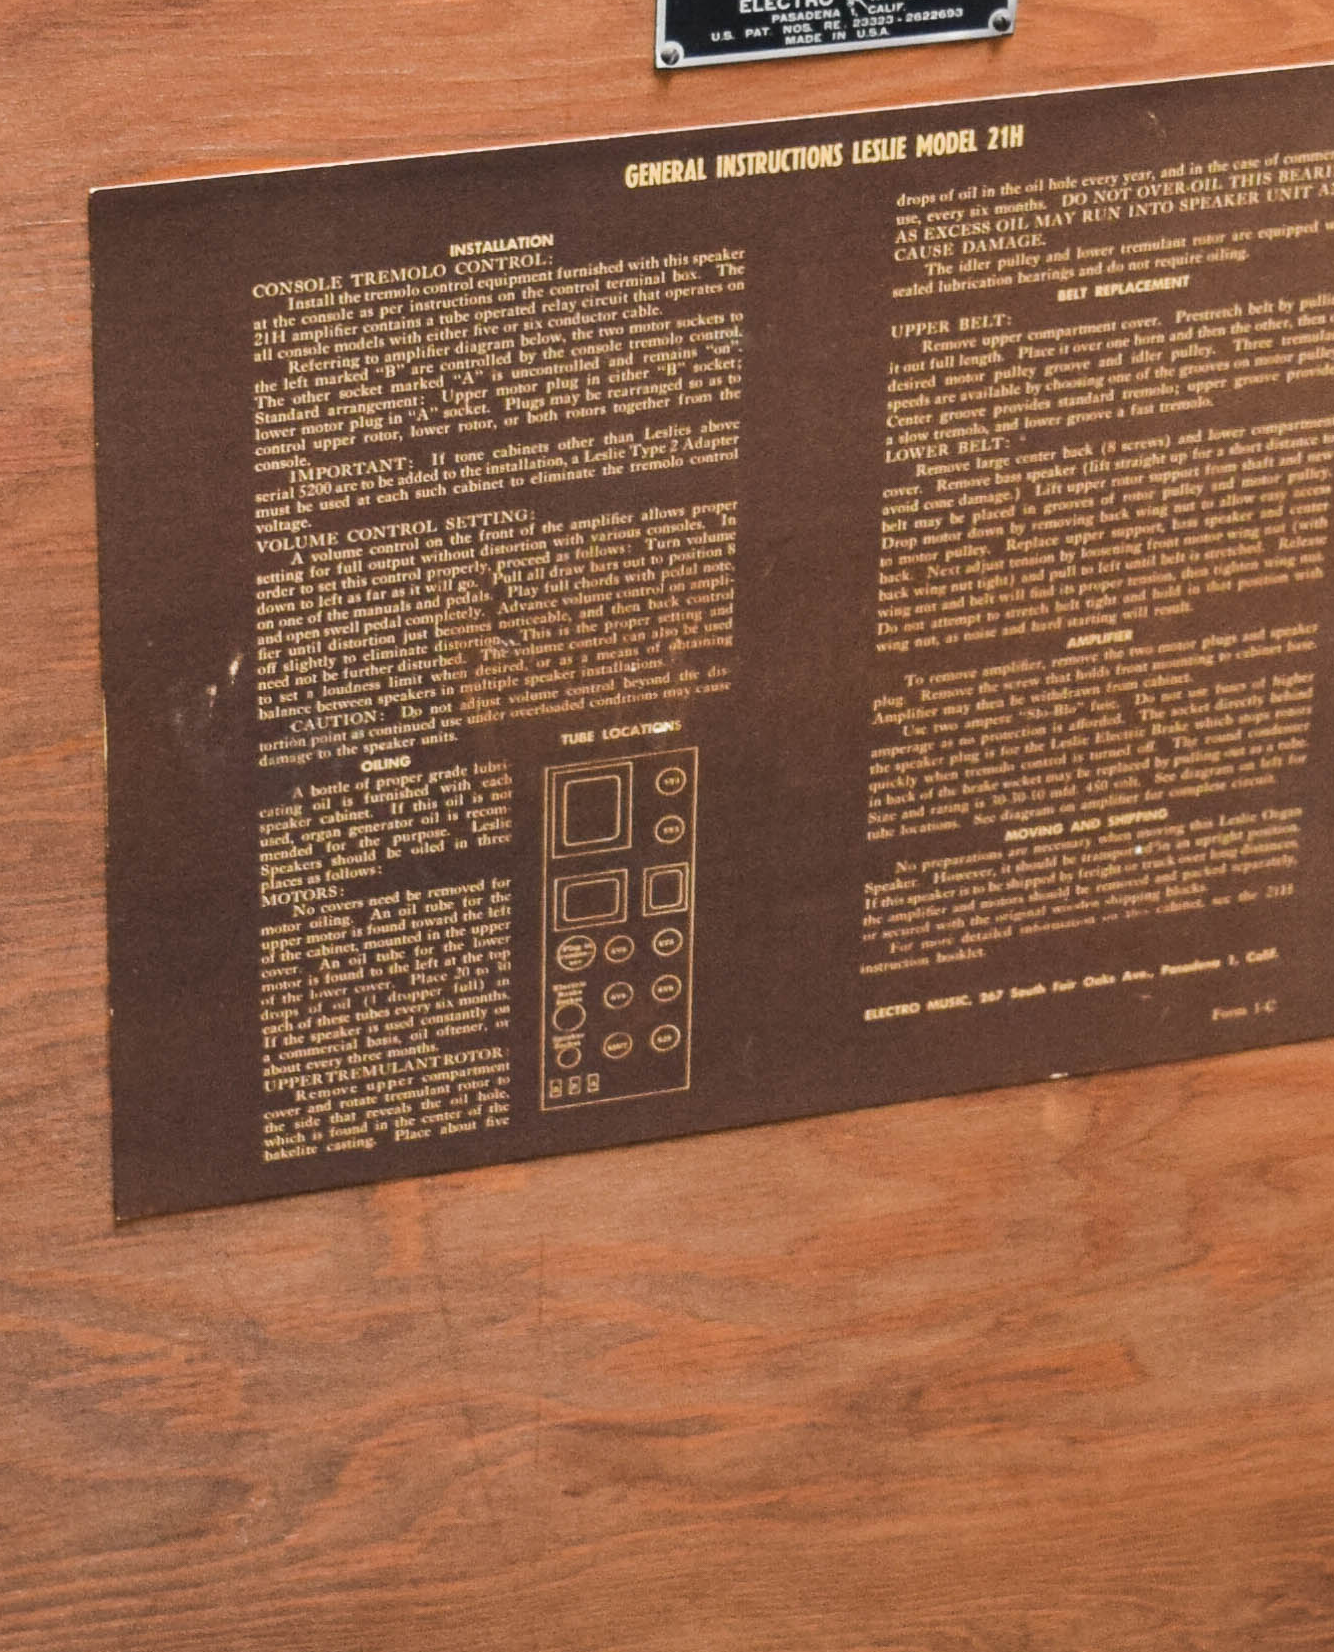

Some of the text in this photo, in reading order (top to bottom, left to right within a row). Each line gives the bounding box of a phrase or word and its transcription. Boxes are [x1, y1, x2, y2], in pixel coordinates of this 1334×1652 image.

[771, 9, 841, 24] PASADENA
[785, 33, 822, 45] MADE
[832, 32, 847, 42] IN
[624, 123, 1025, 189] GENERAL INSTRUCTIONS LESLIE MODEL 21H
[926, 210, 964, 222] every
[1061, 192, 1088, 208] DO
[1093, 186, 1132, 204] NOT
[1136, 177, 1222, 199] OVER-OIL
[1229, 172, 1272, 189] THIS
[894, 229, 918, 244] AS
[924, 220, 991, 241] EXCESS
[996, 216, 1029, 232] OIL
[1035, 210, 1076, 228] MAY
[1082, 205, 1121, 223] RUN
[1128, 200, 1174, 218] INTO
[1179, 191, 1260, 212] SPEAKER
[1266, 185, 1314, 202] UNIT
[449, 233, 555, 258] INSTALLATION
[893, 242, 954, 262] CAUSE
[251, 252, 553, 299] CONSOLE TREMOLO CONTROL:
[288, 248, 746, 311] Install the tremolo control equipment furnished with this speaker
[1056, 273, 1191, 303] BELT REPLACEMENT
[253, 264, 746, 331] at the console as per instructions on the control terminal box. The
[890, 319, 951, 339] UPPER
[289, 456, 414, 484] IMPORTANT:
[454, 450, 485, 464] tone
[492, 442, 550, 459] cabinets
[557, 436, 595, 451] other
[603, 432, 634, 446] than
[644, 425, 692, 441] Leslies
[699, 420, 741, 434] above
[884, 443, 949, 464] LOWER
[255, 508, 536, 554] VOLUME CONTROL SETTING:
[559, 719, 682, 746] TUBE LOCATIONS
[359, 754, 412, 773] OILING
[258, 865, 383, 895] places as follows:
[260, 885, 345, 908] MOTORS:
[292, 877, 512, 918] No covers need be removed for
[263, 1073, 323, 1093] UPPER
